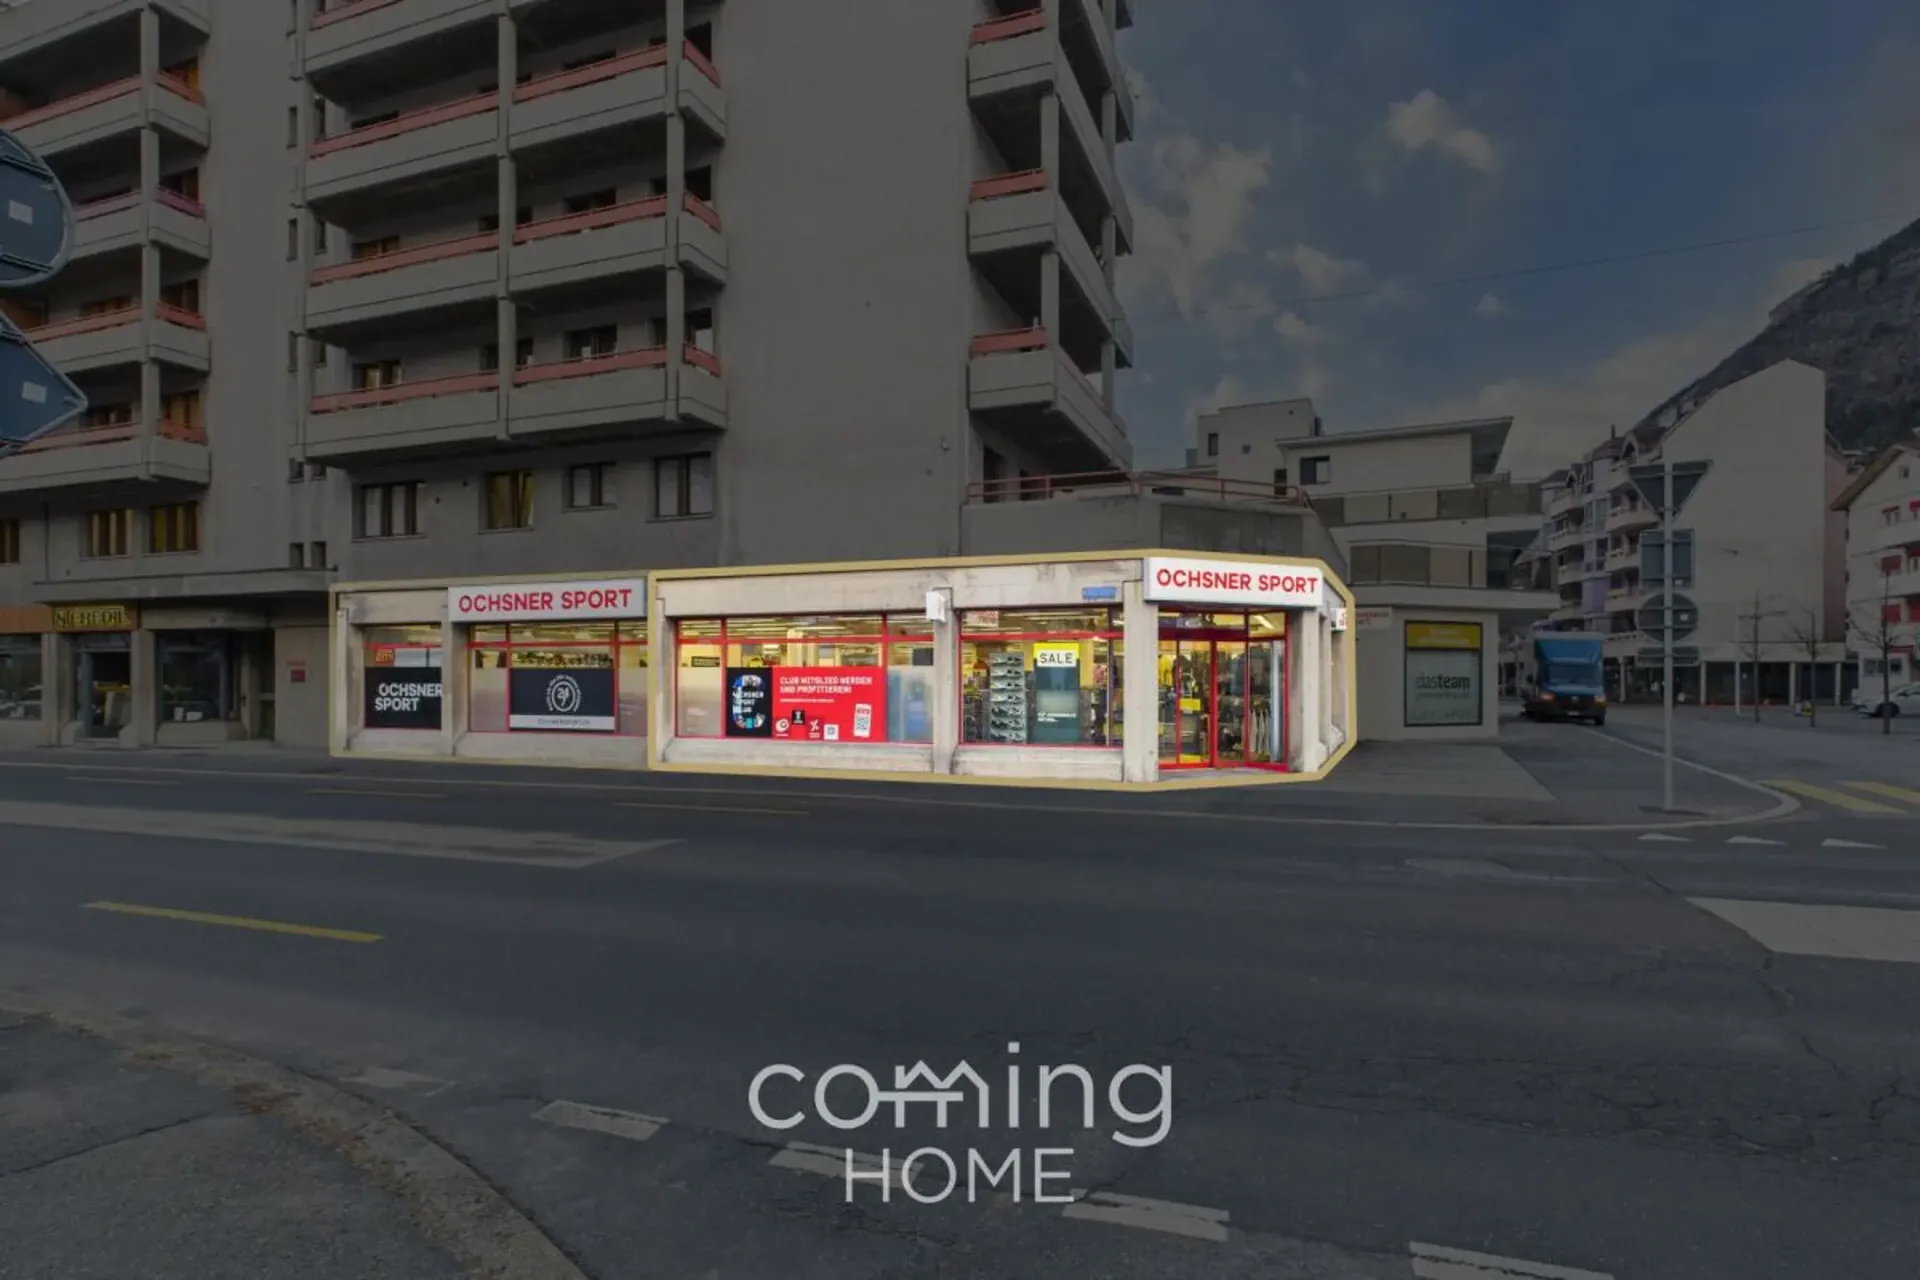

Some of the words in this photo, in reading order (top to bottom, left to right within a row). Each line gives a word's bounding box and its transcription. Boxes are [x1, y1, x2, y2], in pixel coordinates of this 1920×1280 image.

[1156, 568, 1252, 590] OCHSNER
[1258, 574, 1318, 593] SPORT
[458, 592, 553, 613] OCHSNER
[561, 588, 632, 610] SPORT
[1040, 652, 1073, 664] SALE
[379, 683, 442, 697] OCHSNER
[375, 697, 419, 711] SPORT
